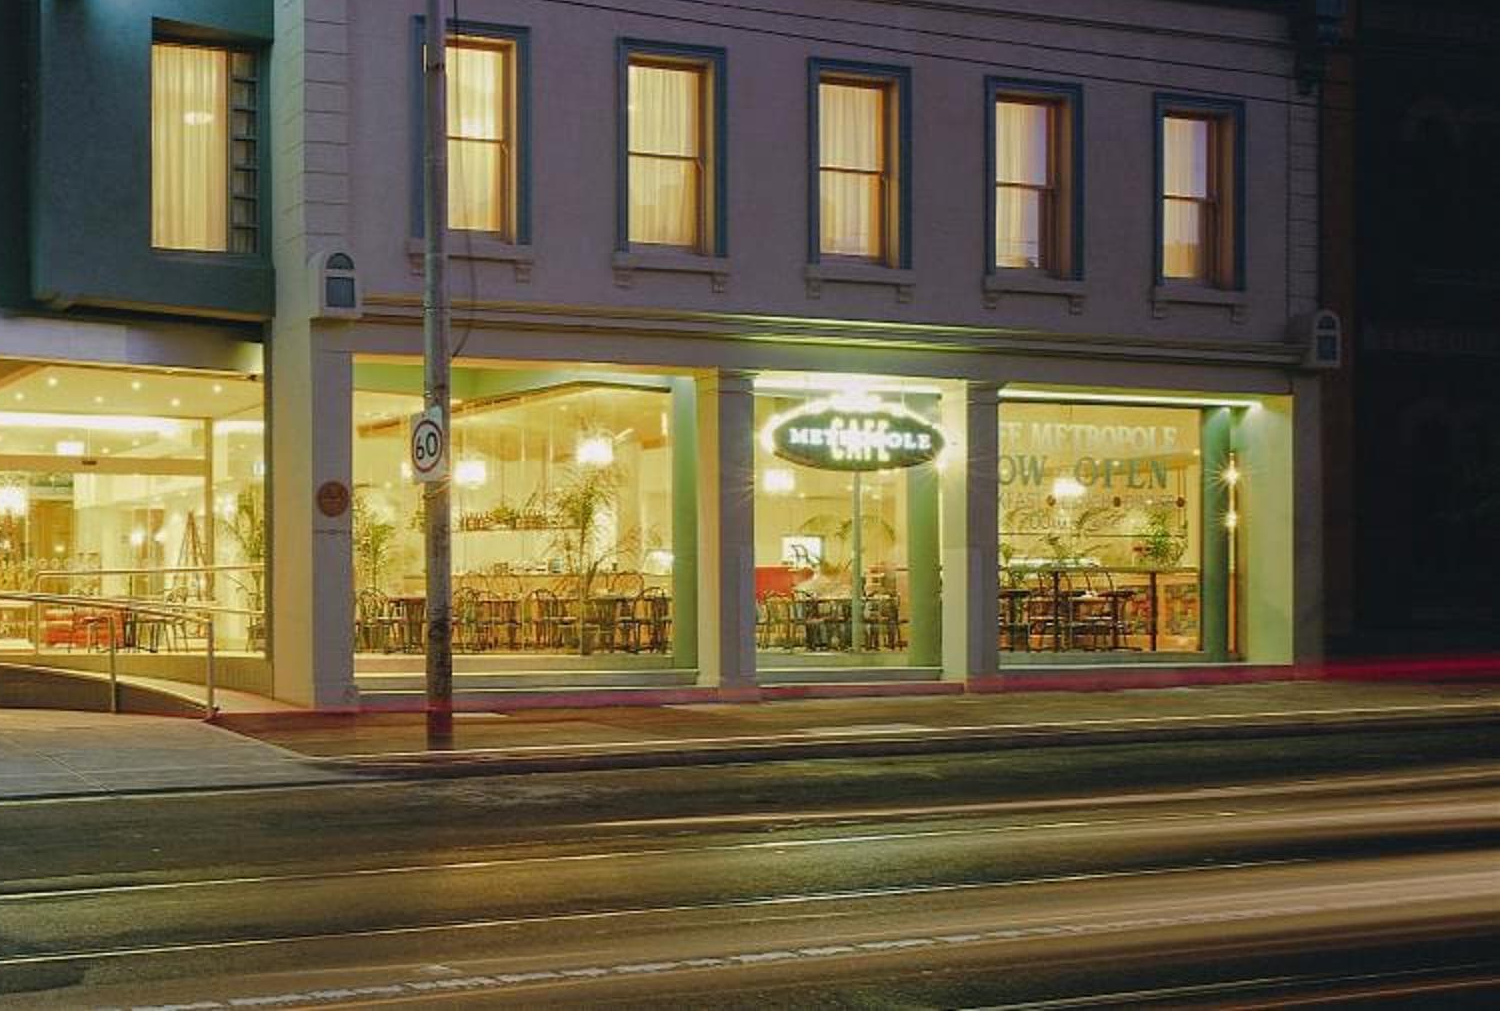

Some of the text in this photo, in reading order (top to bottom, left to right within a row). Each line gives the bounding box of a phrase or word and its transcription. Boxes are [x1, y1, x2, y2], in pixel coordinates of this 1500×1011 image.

[415, 431, 438, 461] 60
[1030, 422, 1179, 451] METROPOLE
[1074, 456, 1168, 490] OPEN
